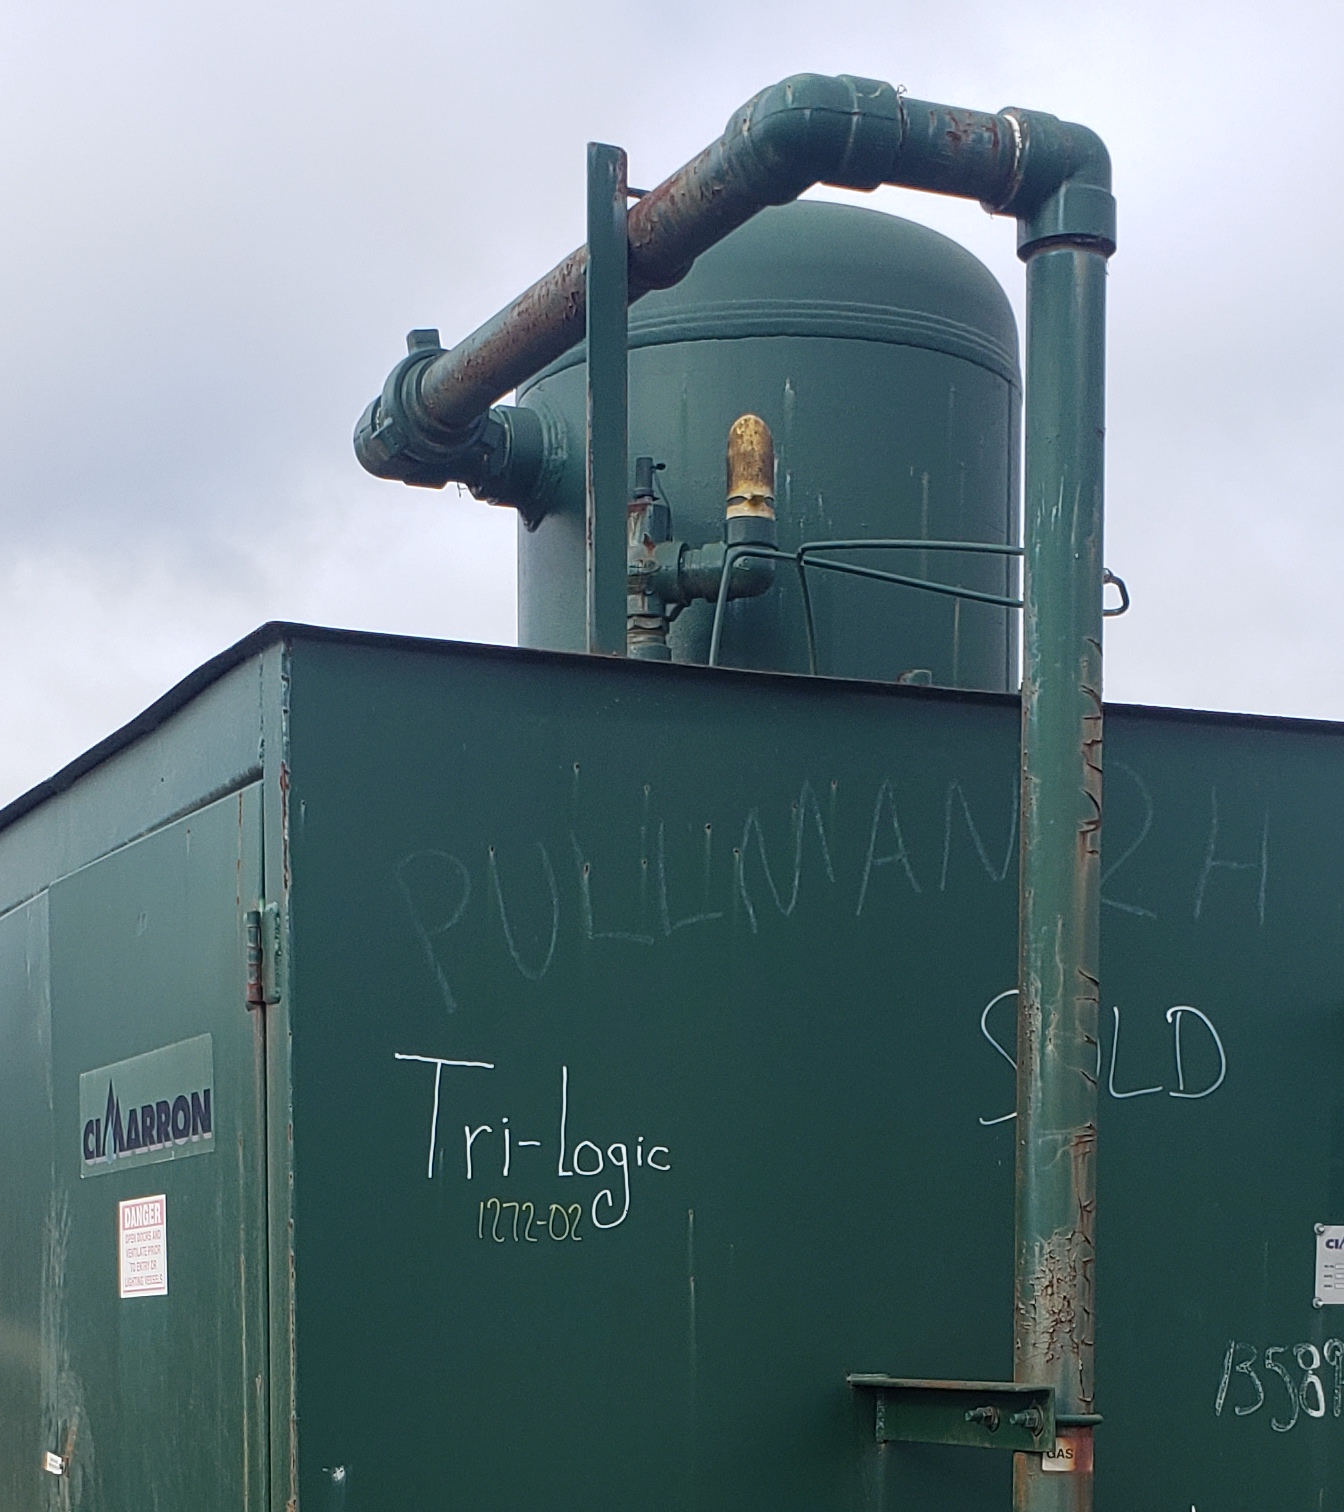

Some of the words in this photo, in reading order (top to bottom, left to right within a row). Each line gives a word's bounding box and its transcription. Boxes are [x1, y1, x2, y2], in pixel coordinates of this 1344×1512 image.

[980, 989, 1226, 1126] SLD
[83, 1078, 212, 1164] CIMARRON
[395, 1052, 671, 1229] Tri-Logic
[124, 1202, 162, 1229] DANGER
[479, 1198, 583, 1243] 1272-02
[1046, 1448, 1074, 1459] GAS
